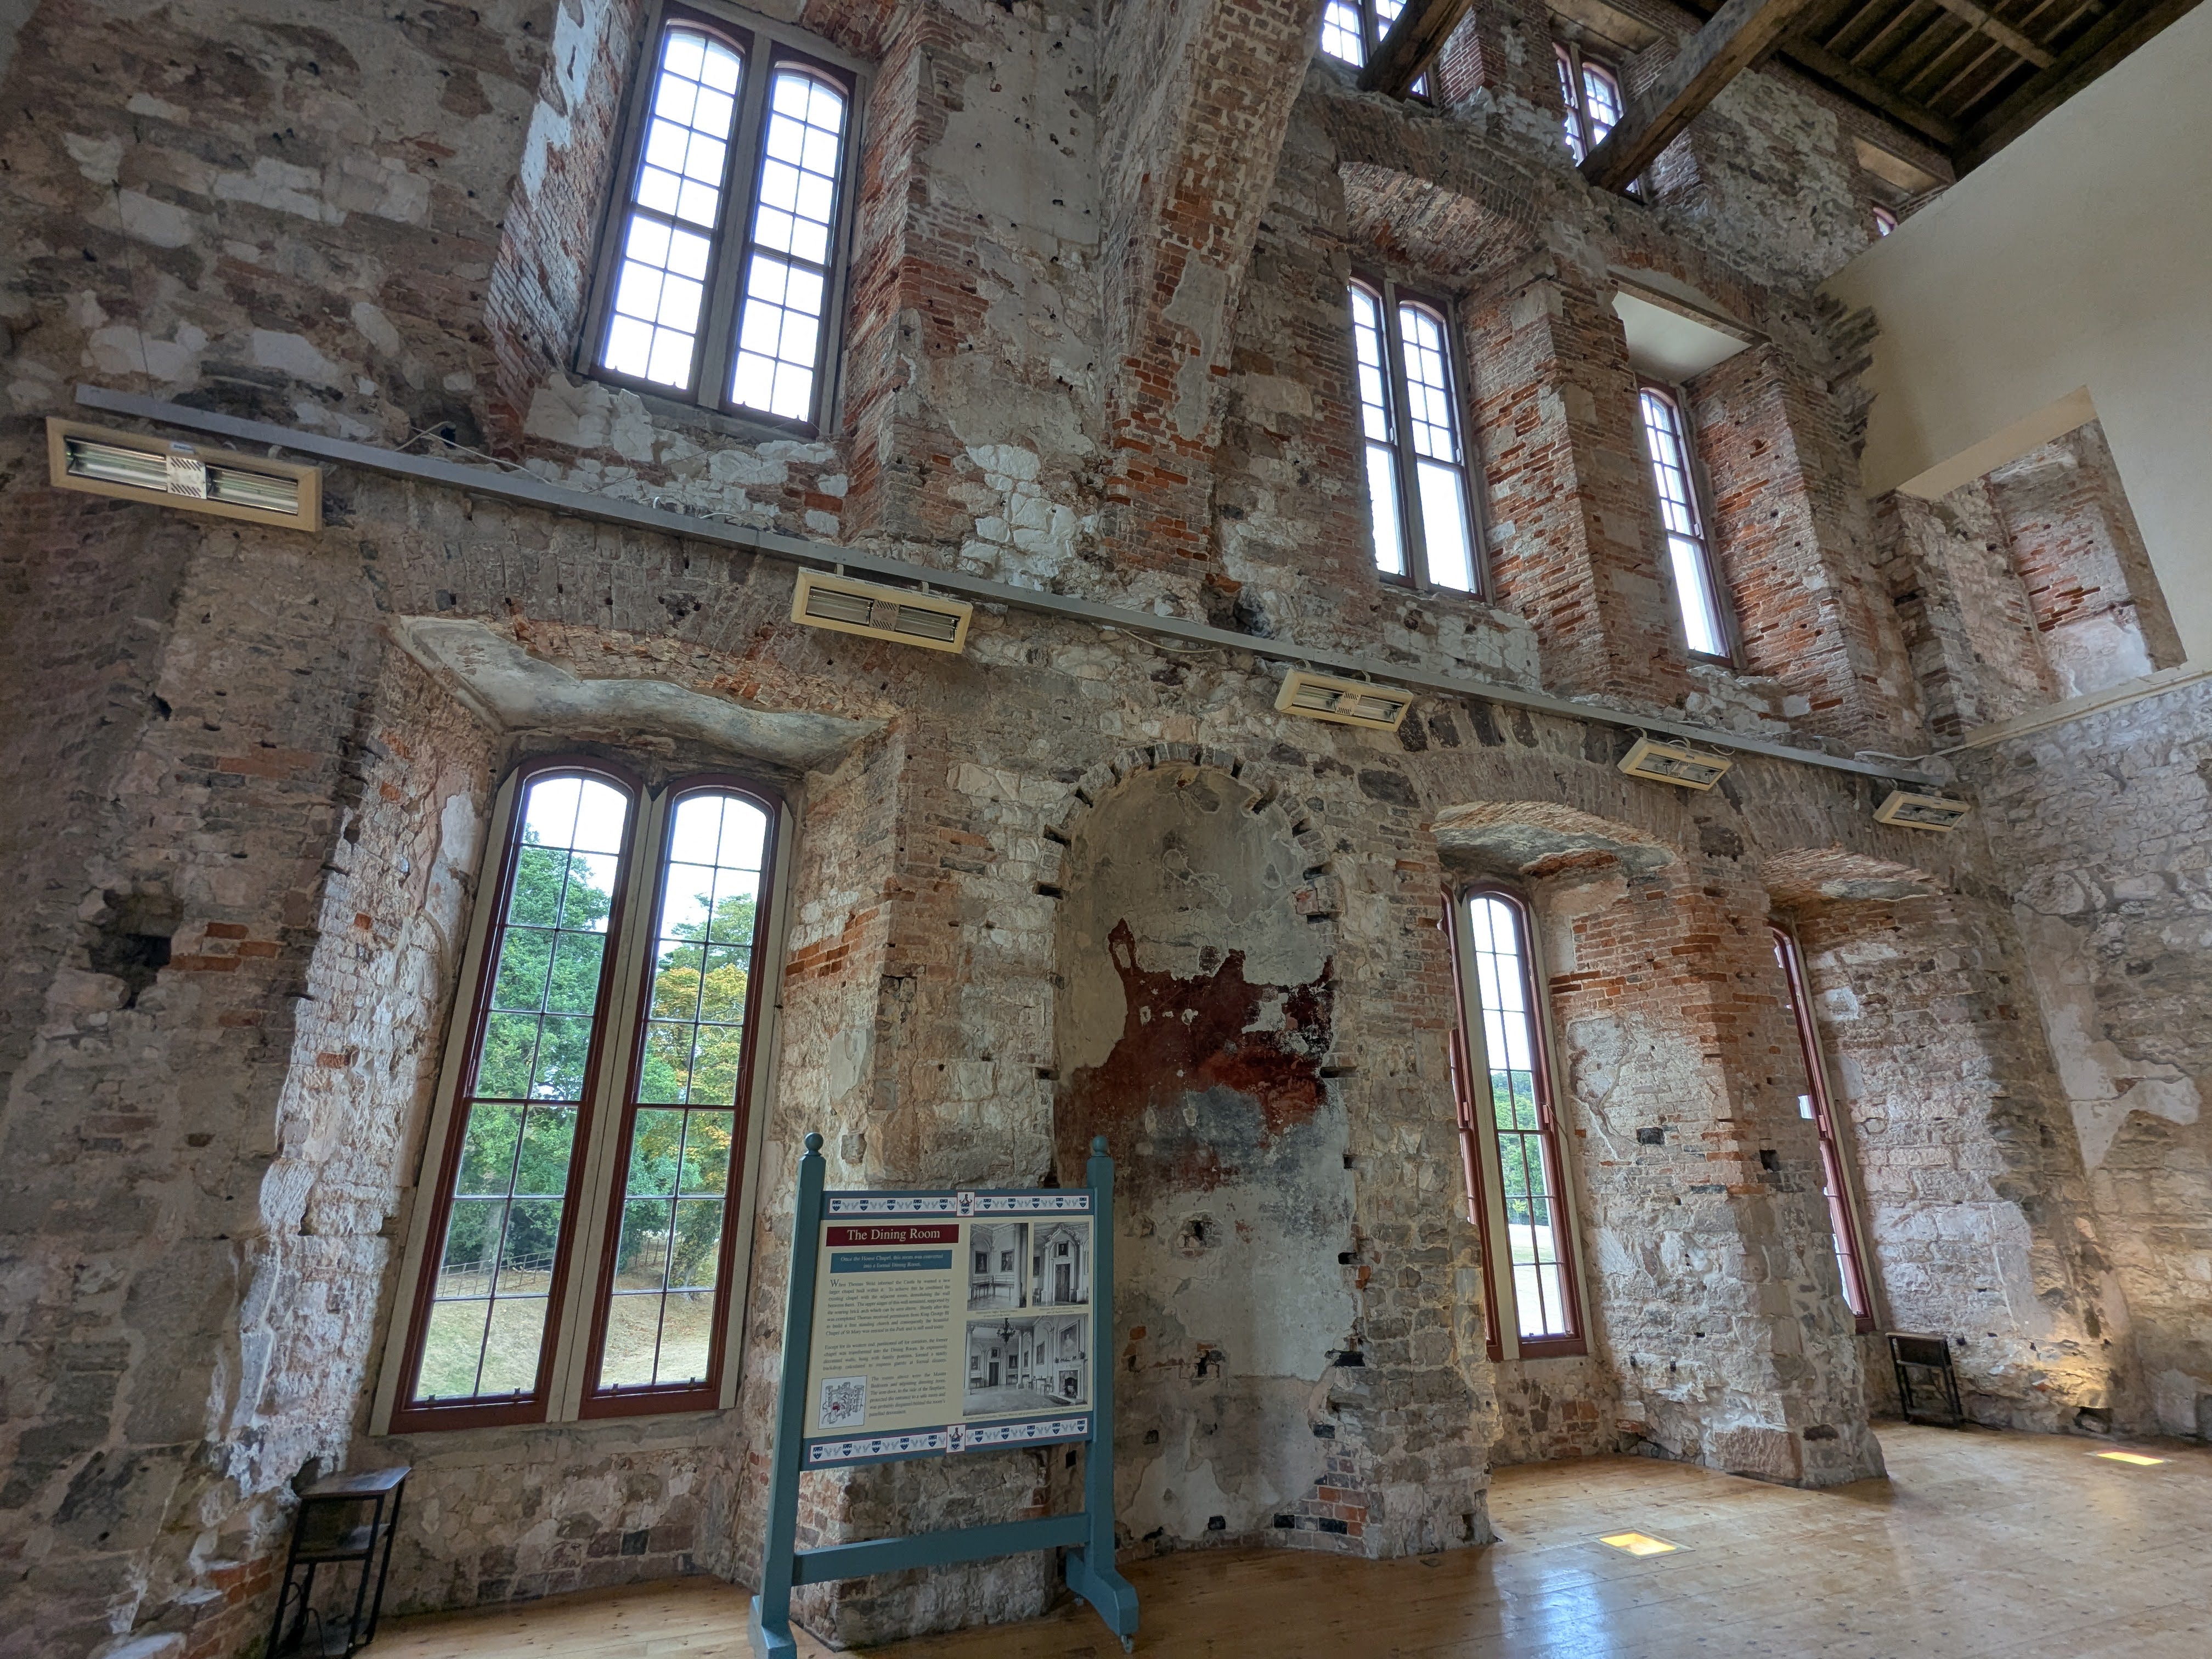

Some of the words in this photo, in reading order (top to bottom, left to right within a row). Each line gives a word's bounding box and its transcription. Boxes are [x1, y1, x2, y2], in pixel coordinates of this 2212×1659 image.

[847, 1229, 867, 1240] The
[871, 1229, 906, 1242] Dining
[910, 1228, 940, 1239] Room
